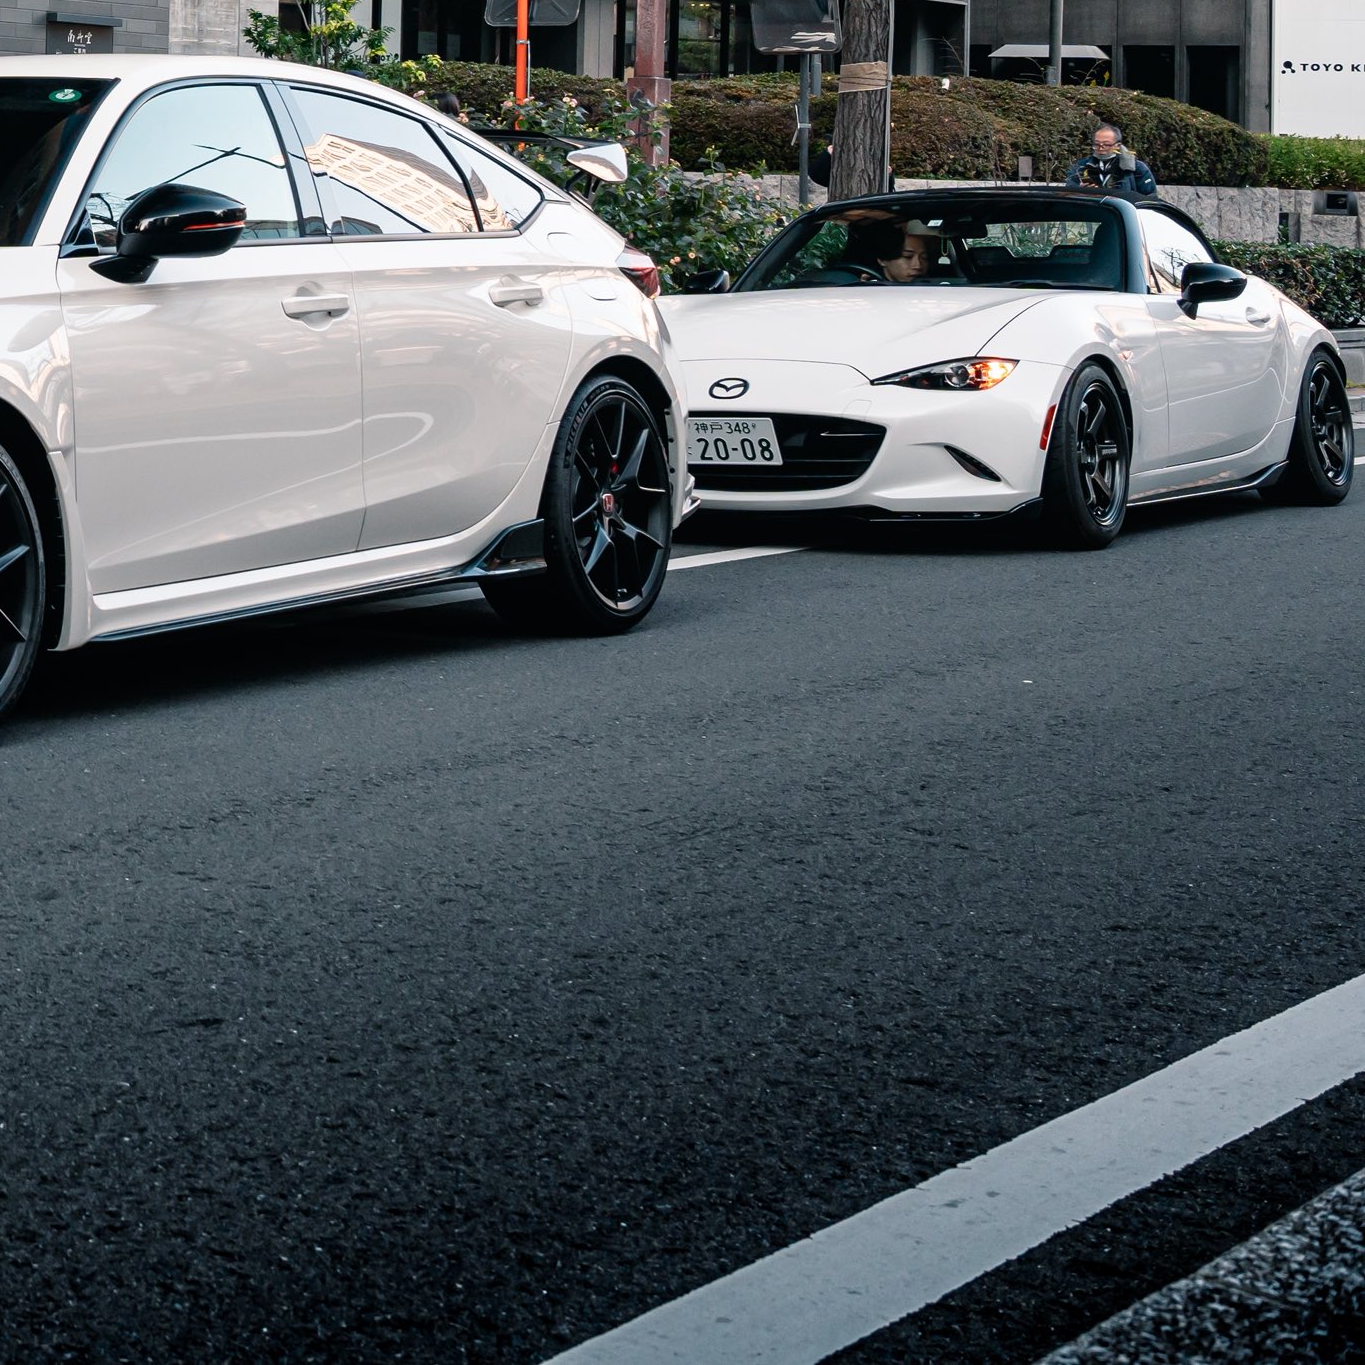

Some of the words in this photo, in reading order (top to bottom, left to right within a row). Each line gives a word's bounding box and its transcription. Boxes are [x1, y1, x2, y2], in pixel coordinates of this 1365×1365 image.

[1300, 63, 1344, 72] TOYO
[1351, 63, 1365, 72] K
[696, 437, 774, 462] 20-08
